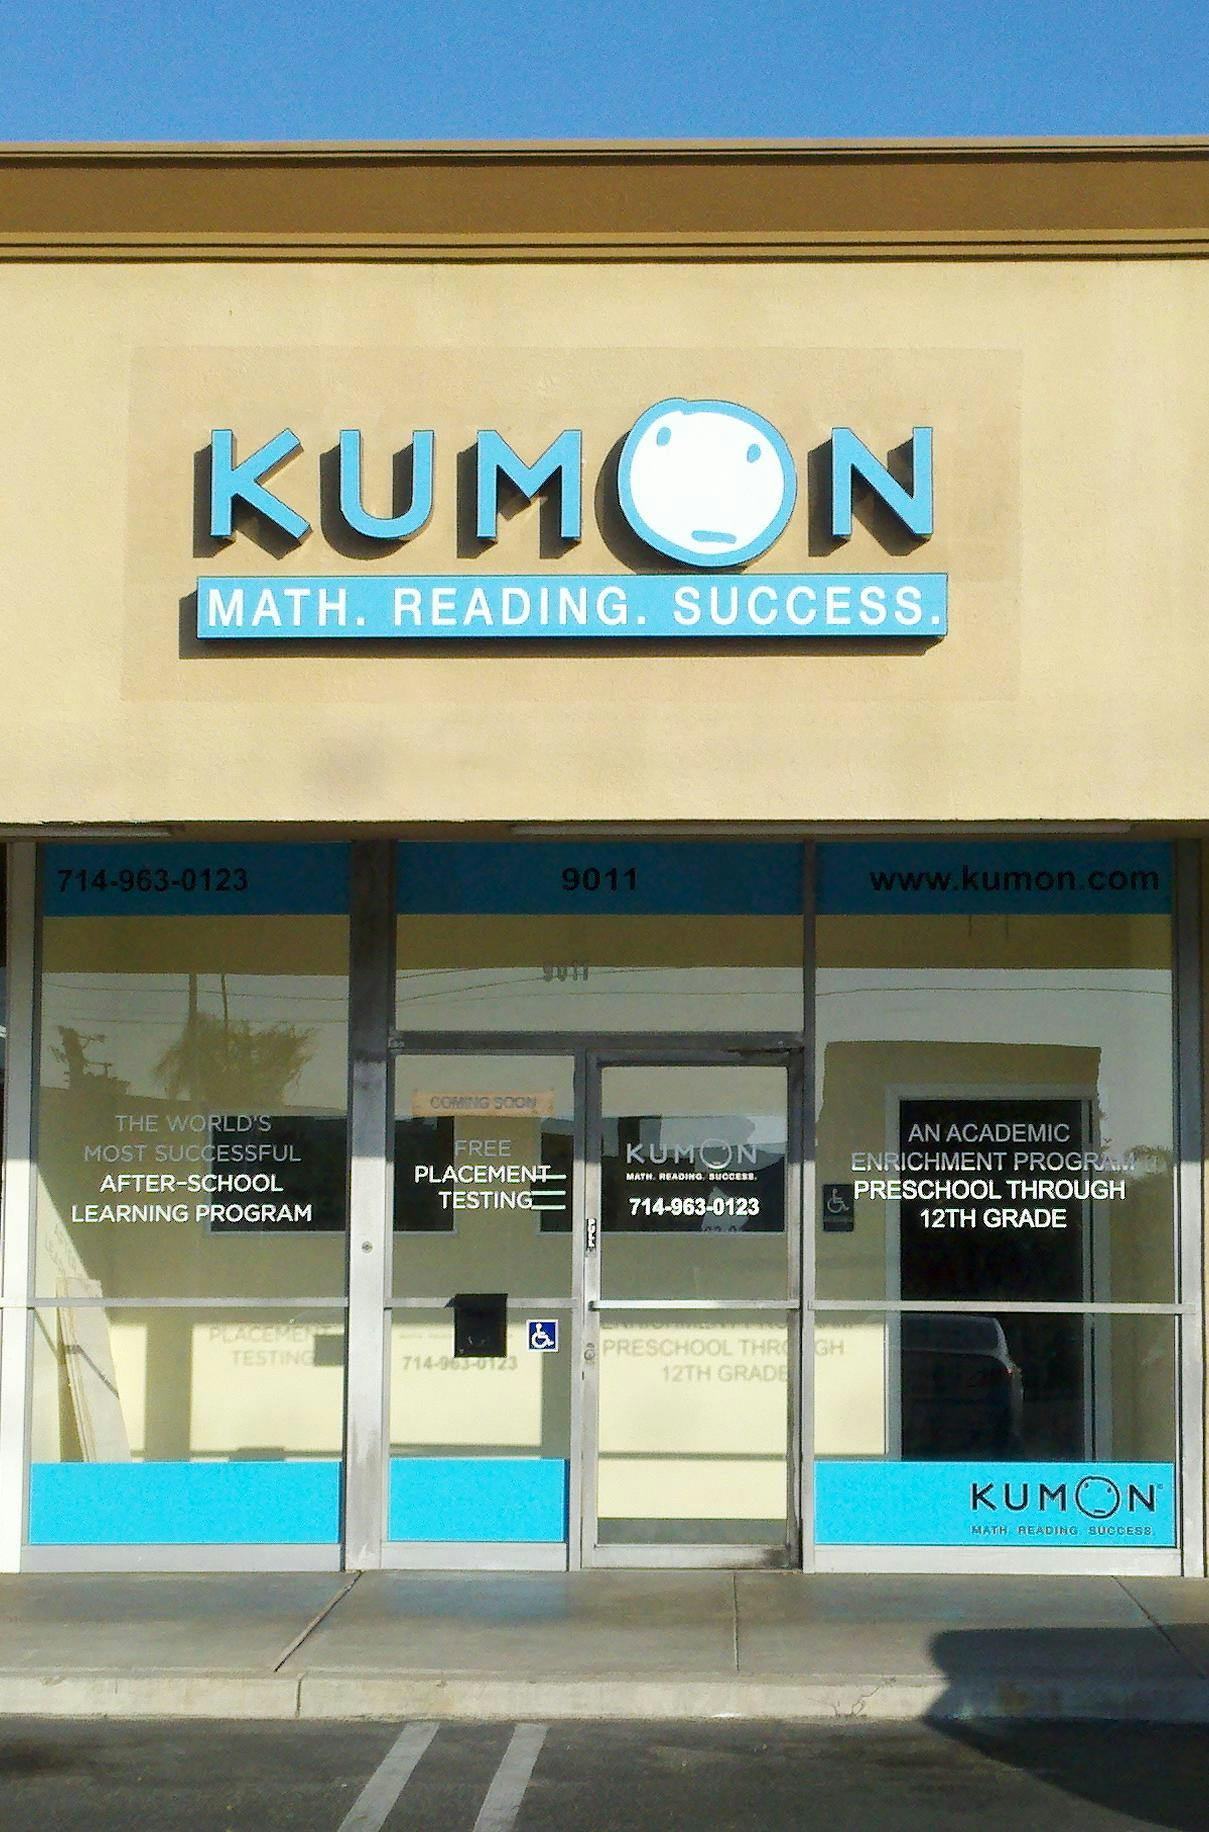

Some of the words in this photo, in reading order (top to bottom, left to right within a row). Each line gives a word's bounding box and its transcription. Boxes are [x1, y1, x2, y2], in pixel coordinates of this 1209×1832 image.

[210, 397, 934, 568] KUMON
[208, 587, 367, 628] MATH.
[394, 586, 647, 628] READING.
[672, 585, 941, 627] SUCCESS.
[57, 868, 249, 893] 714-963-0123
[561, 866, 638, 892] 9011
[869, 864, 1160, 893] www.kumon.com
[430, 1095, 490, 1110] COMING
[494, 1095, 537, 1110] SOON
[115, 1113, 159, 1133] THE
[166, 1113, 272, 1134] WORLD'S
[907, 1122, 940, 1143] AN
[946, 1122, 1071, 1143] ACADEMIC
[84, 1144, 148, 1163] MOST
[155, 1144, 302, 1163] SUCCESSFUL
[454, 1139, 512, 1158] FREE
[626, 1138, 759, 1170] KUMON
[850, 1151, 1008, 1172] ENRICHMENT
[1013, 1151, 1136, 1172] PROGRAM
[99, 1173, 284, 1193] AFTER-SCHOOL
[414, 1164, 551, 1184] PLACEMENT
[625, 1172, 656, 1182] MATH.
[658, 1172, 705, 1182] READING.
[708, 1172, 758, 1182] SUCCESS.
[438, 1190, 533, 1210] TESTING
[853, 1179, 1002, 1201] PRESCHOOL
[1006, 1179, 1126, 1201] THROUGH
[71, 1203, 189, 1223] LEARNING
[195, 1203, 313, 1223] PROGRAM
[628, 1197, 760, 1217] 714-963-0123
[920, 1207, 977, 1229] 12TH
[983, 1207, 1067, 1229] GRADE
[602, 1338, 733, 1357] PRESCHOOL
[738, 1338, 845, 1357] THROGH
[663, 1364, 711, 1382] 12TH
[971, 1475, 1156, 1519] KUMON
